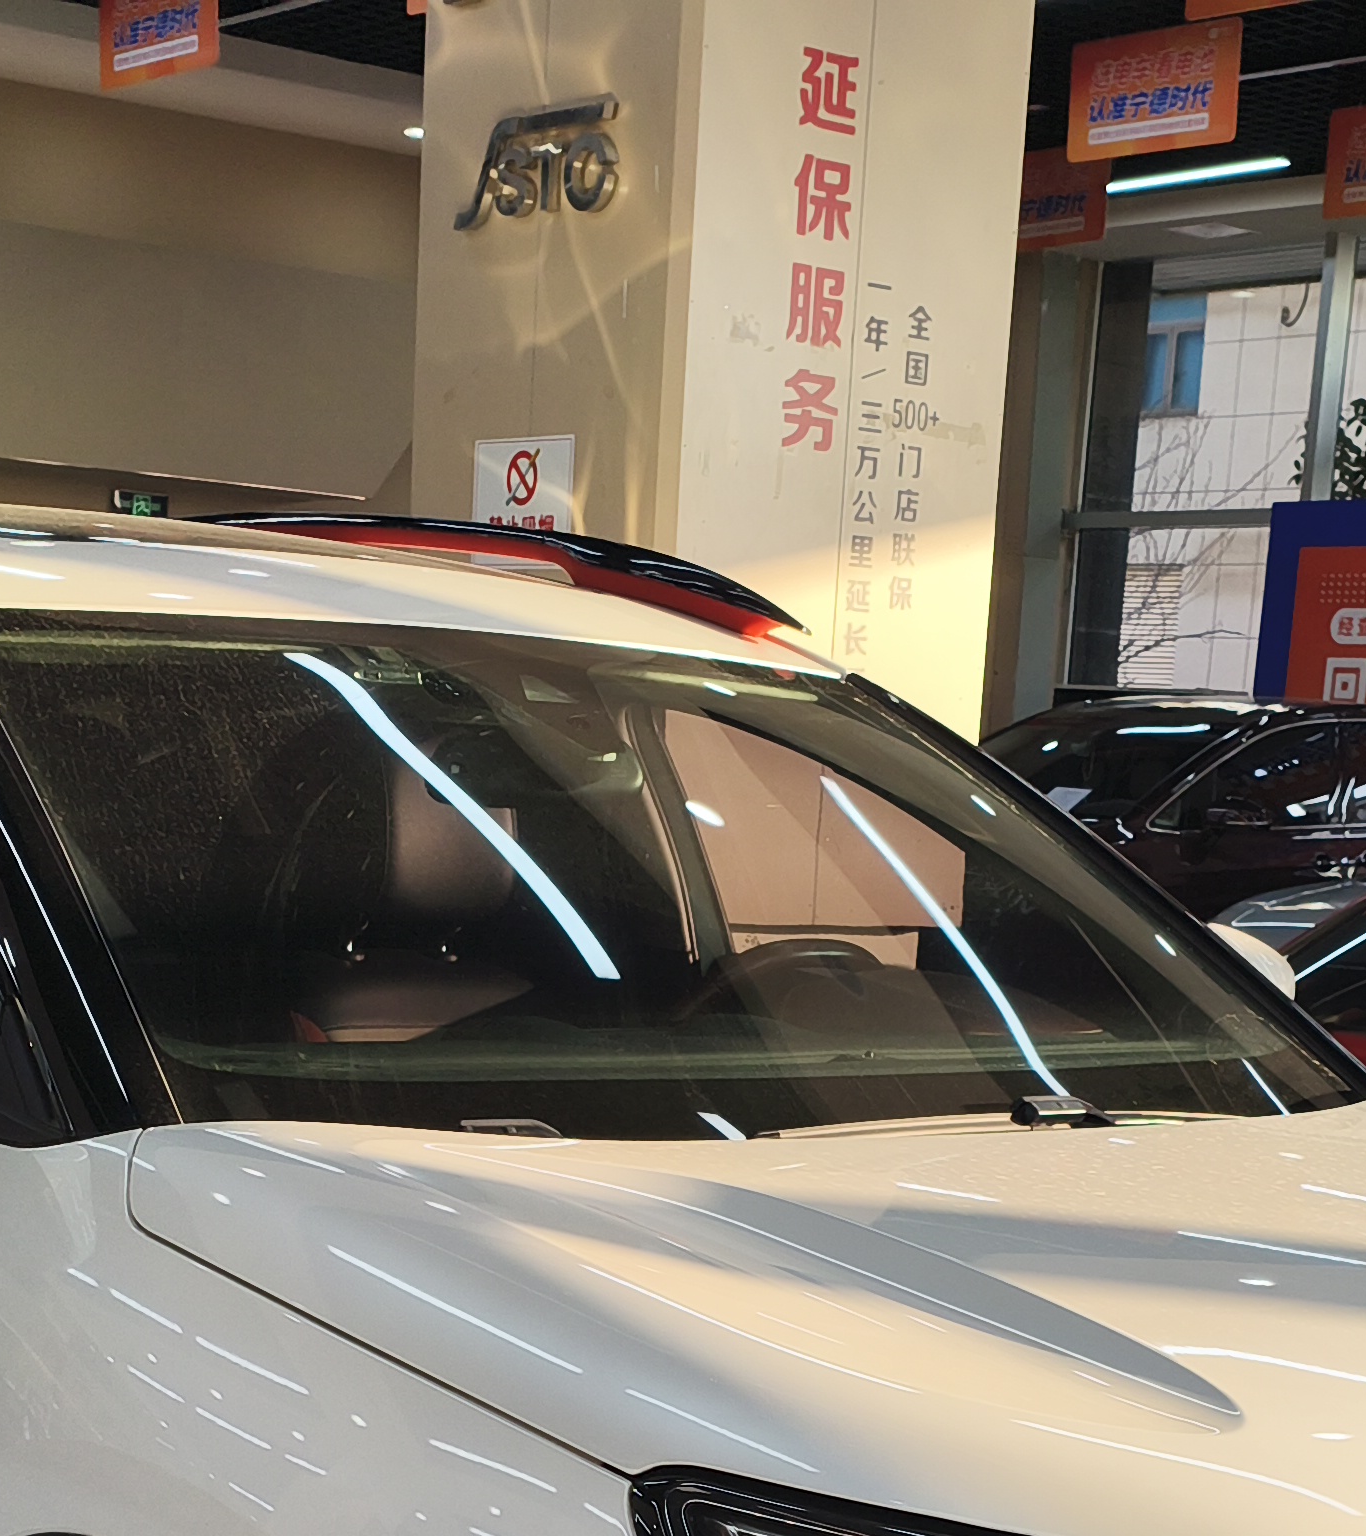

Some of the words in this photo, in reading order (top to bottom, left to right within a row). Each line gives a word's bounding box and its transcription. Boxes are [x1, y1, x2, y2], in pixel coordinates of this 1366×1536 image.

[781, 45, 861, 453] 延保服务
[1088, 80, 1214, 123] 认准宁德时代
[843, 282, 892, 672] 一年/三万公里延长
[888, 305, 939, 611] 全国500+门店联保
